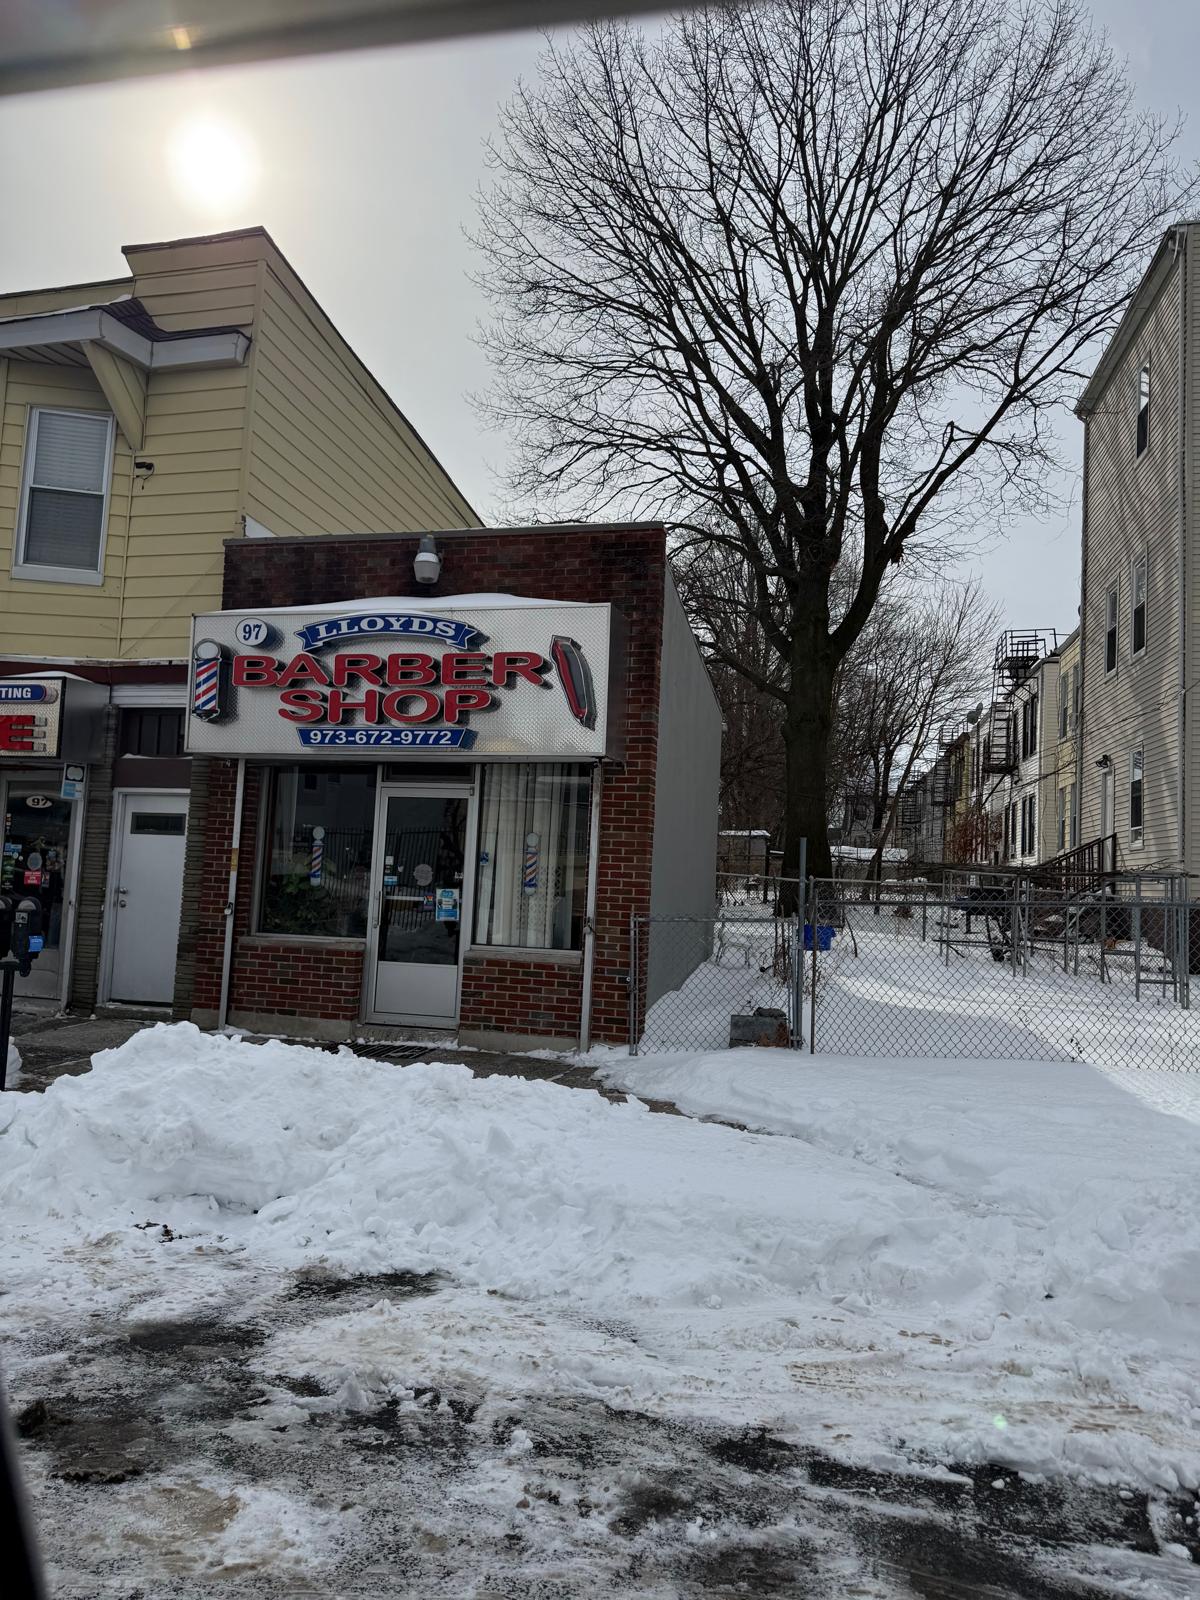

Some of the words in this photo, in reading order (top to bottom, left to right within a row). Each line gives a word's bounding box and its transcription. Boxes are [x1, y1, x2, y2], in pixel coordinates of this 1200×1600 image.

[241, 623, 262, 641] 97
[316, 616, 457, 640] LLOYDS
[231, 651, 544, 688] BARBER
[277, 689, 492, 724] SHOP
[309, 730, 452, 745] 973-672-9772
